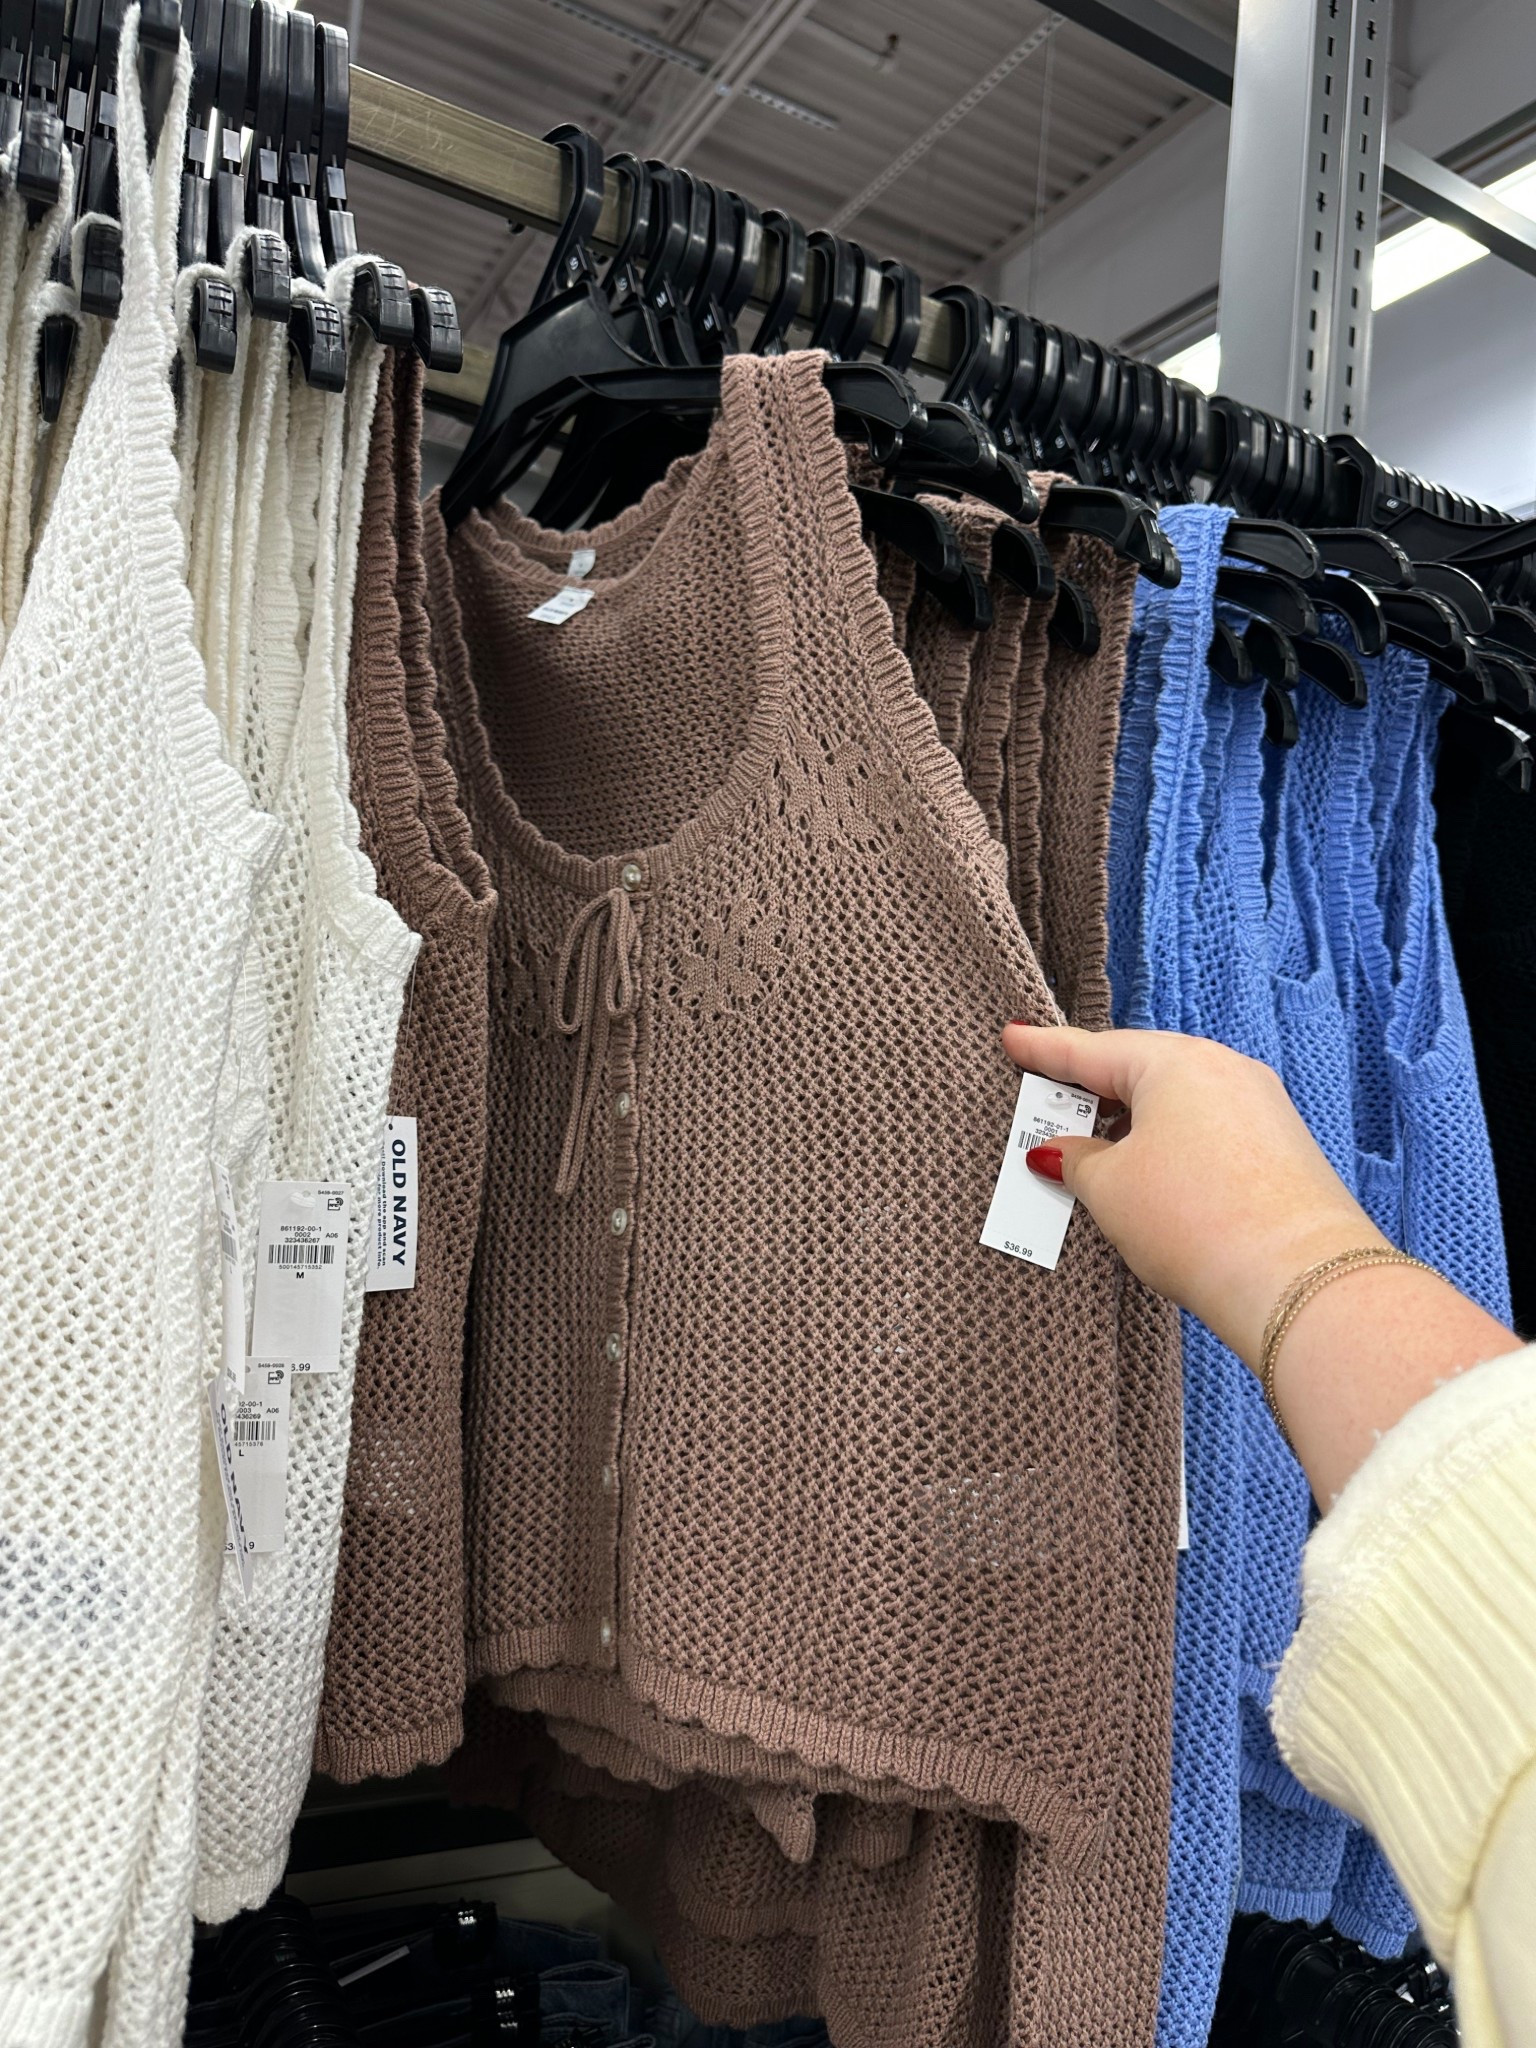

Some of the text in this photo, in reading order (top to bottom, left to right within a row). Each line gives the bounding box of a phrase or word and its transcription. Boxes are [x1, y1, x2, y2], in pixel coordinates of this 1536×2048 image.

[391, 1138, 407, 1266] OLD NAVY
[1003, 1240, 1033, 1258] $36.99
[295, 1271, 305, 1279] M
[238, 1449, 245, 1457] L
